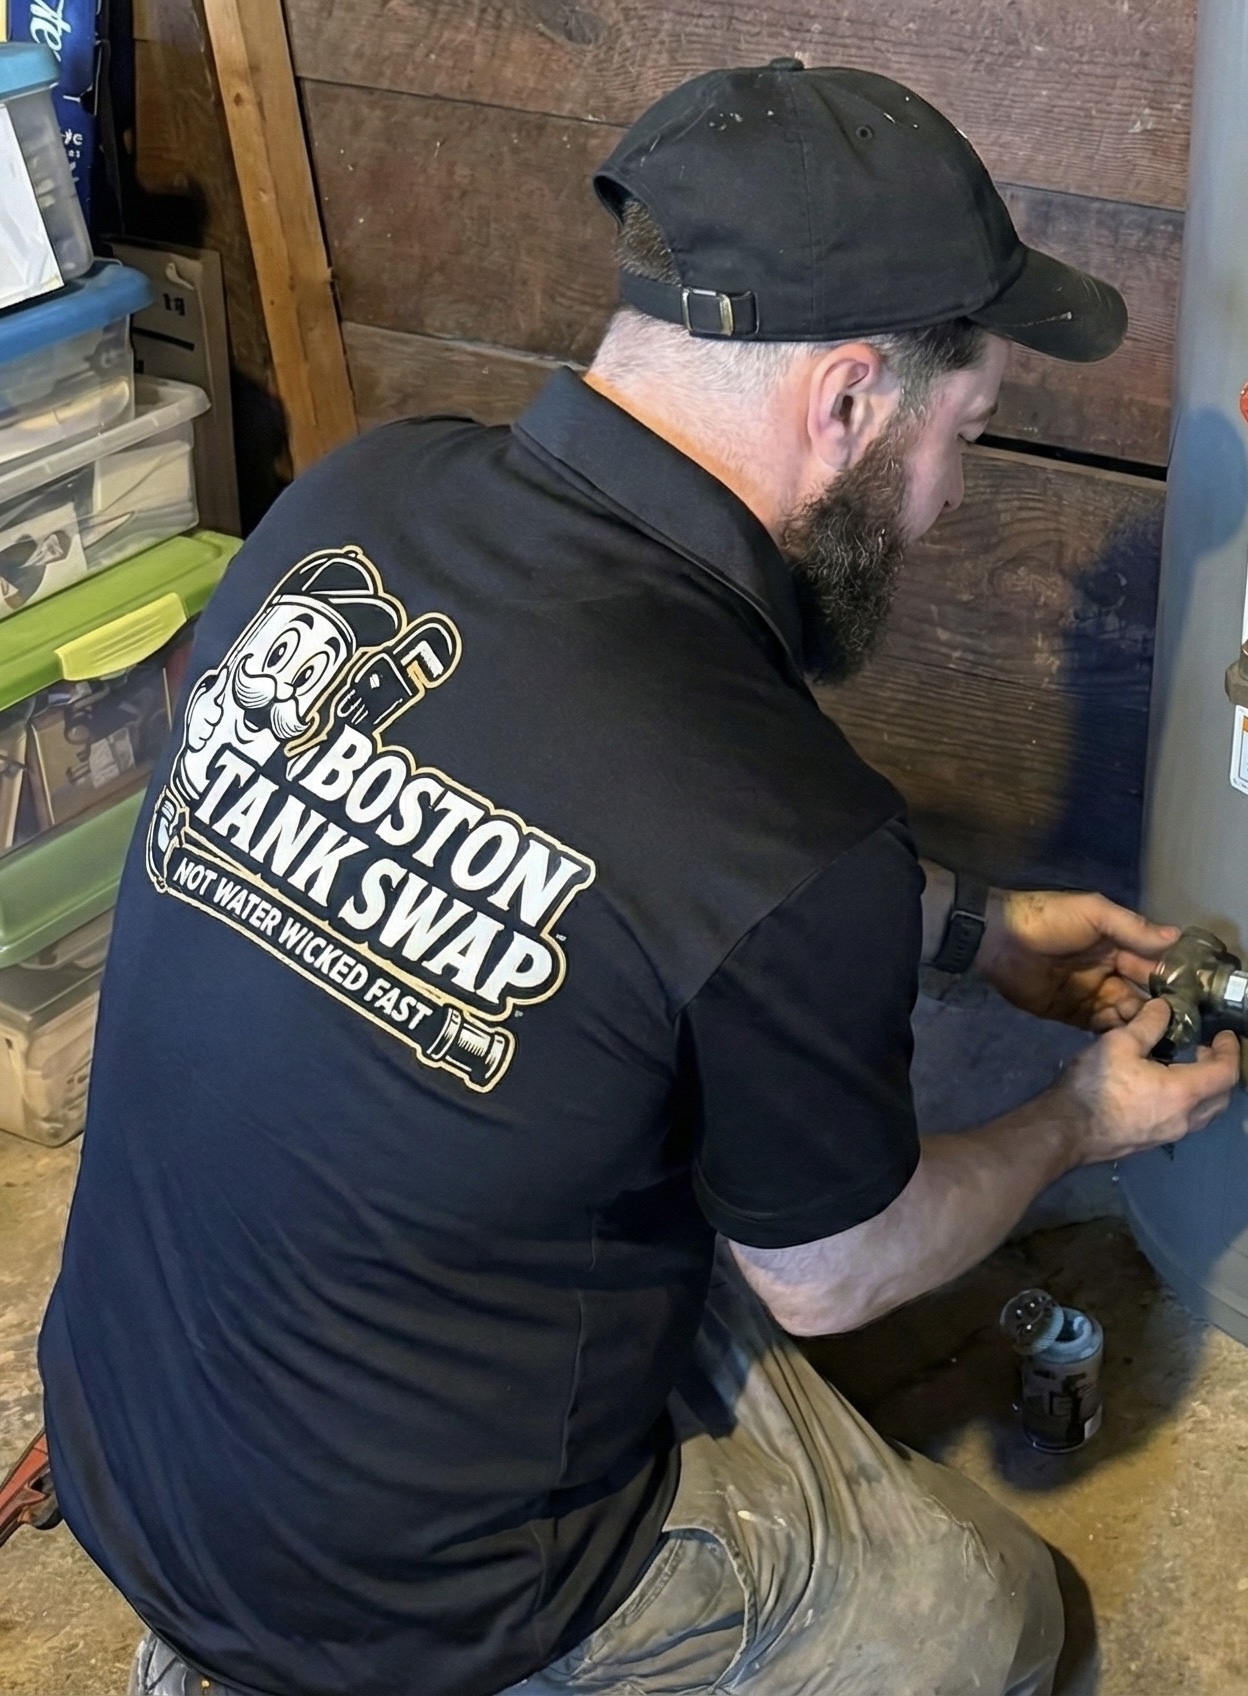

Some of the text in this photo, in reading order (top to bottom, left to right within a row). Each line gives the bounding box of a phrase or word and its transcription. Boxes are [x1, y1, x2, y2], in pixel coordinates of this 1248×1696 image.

[194, 749, 552, 1004] TANK SWAP
[298, 724, 583, 927] BOSTON
[172, 857, 434, 1030] NOT WATER WICKED FAST
